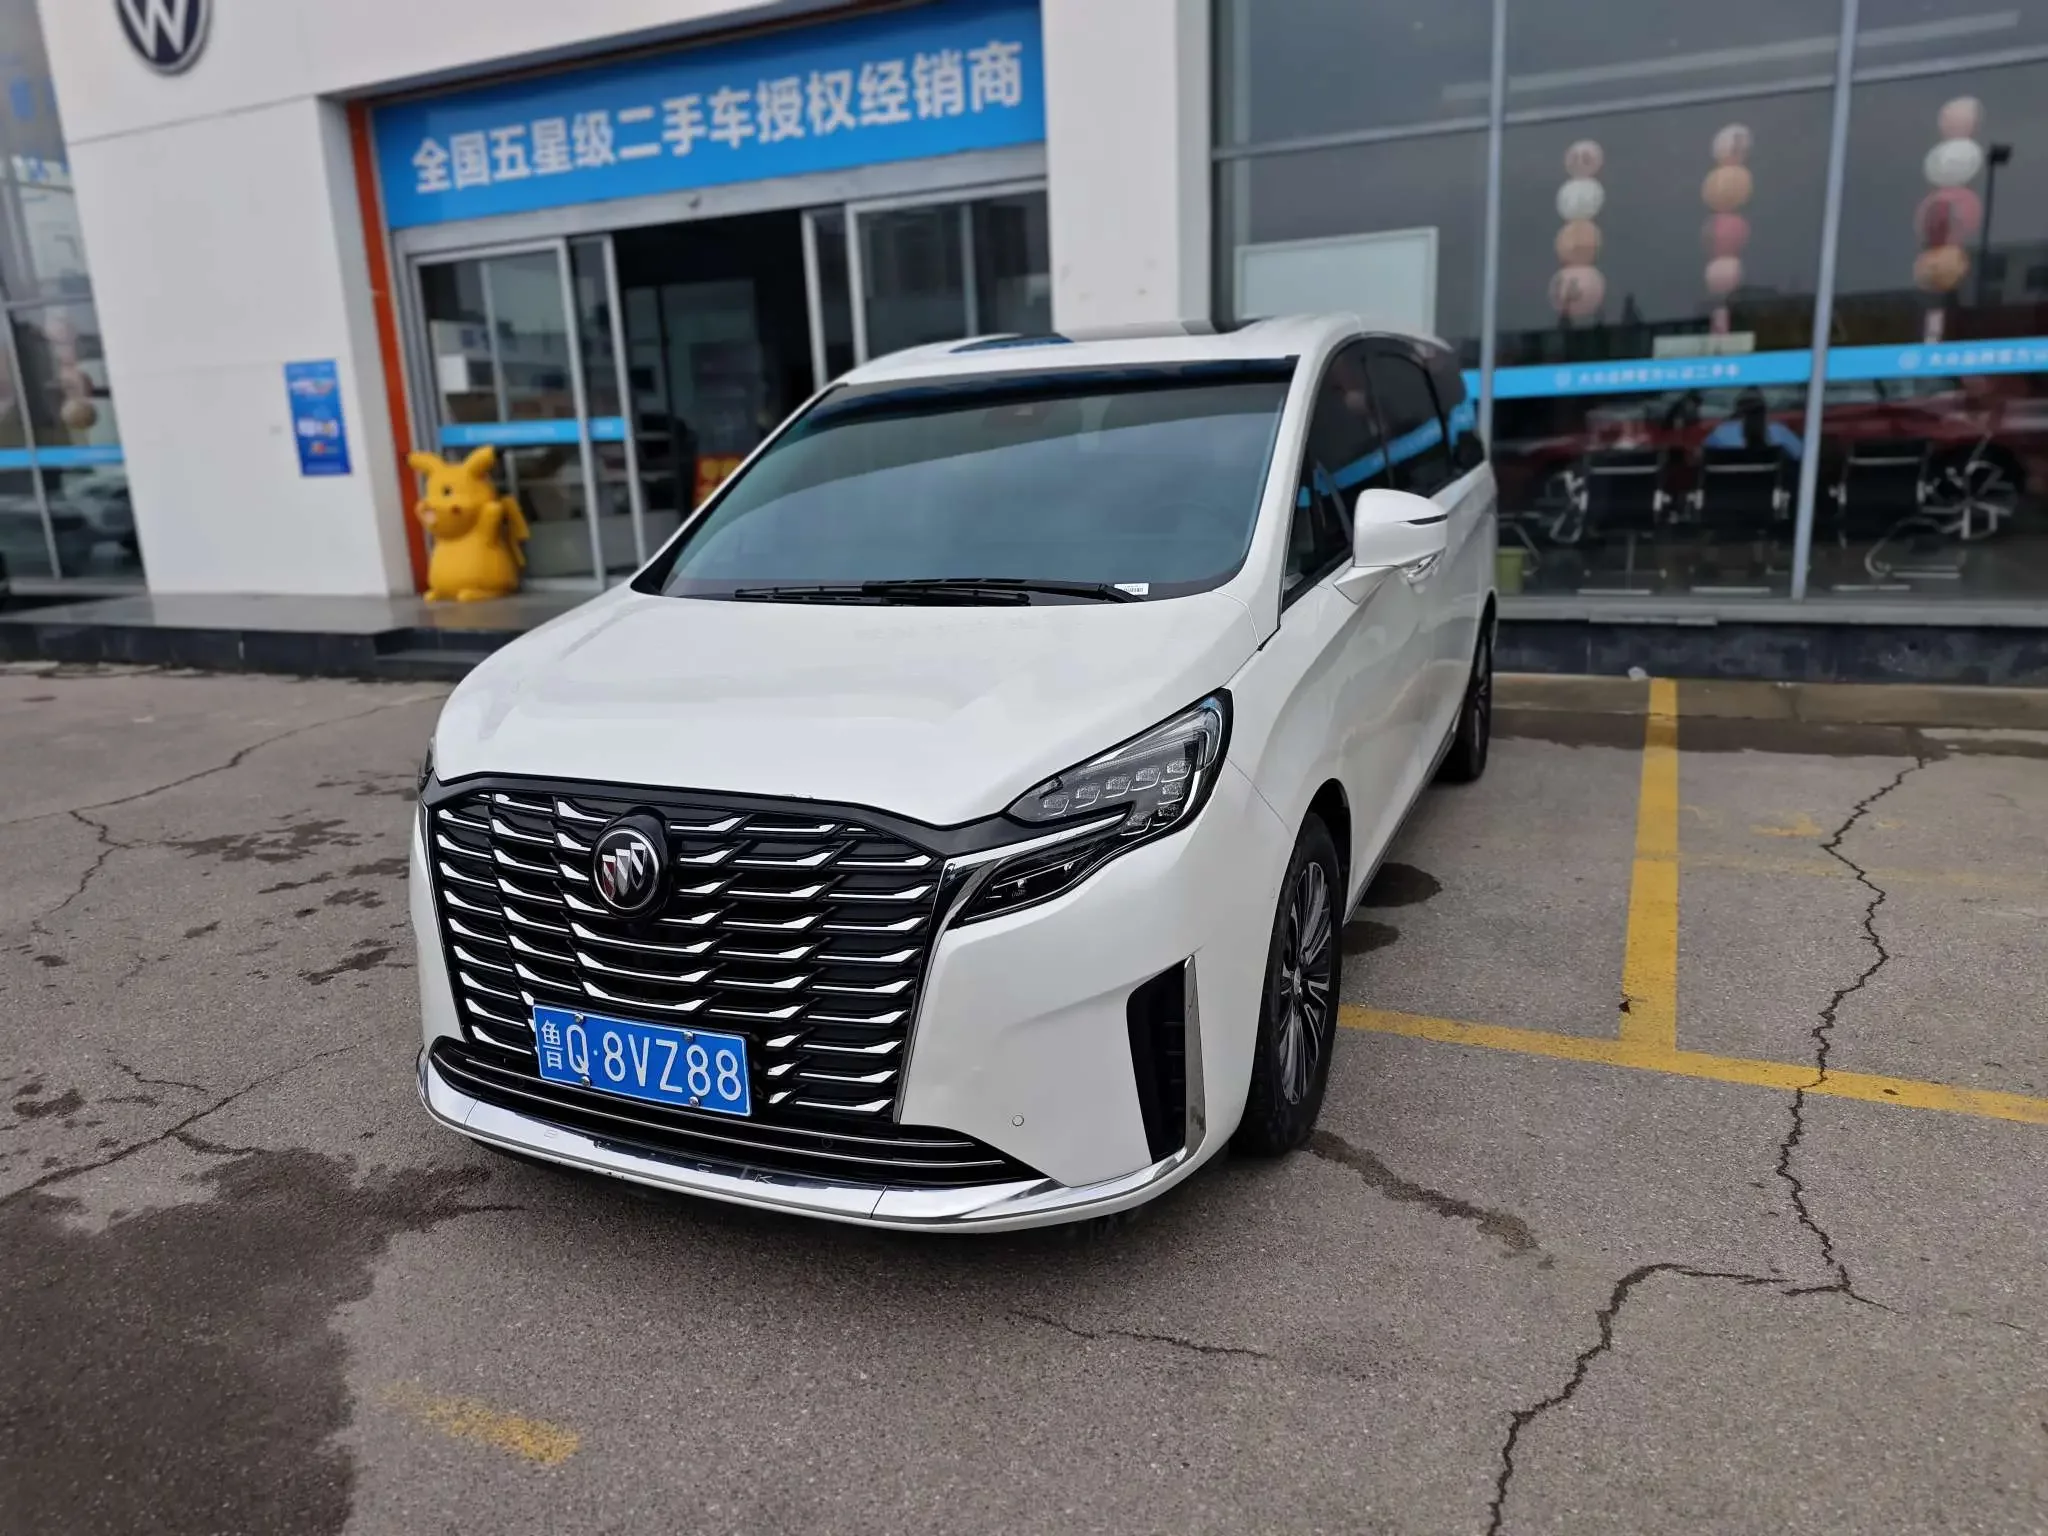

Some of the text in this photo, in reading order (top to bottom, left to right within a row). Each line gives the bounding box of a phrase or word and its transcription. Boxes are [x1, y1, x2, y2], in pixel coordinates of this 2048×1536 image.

[412, 40, 1023, 193] 全国五星级二手车授权经销商
